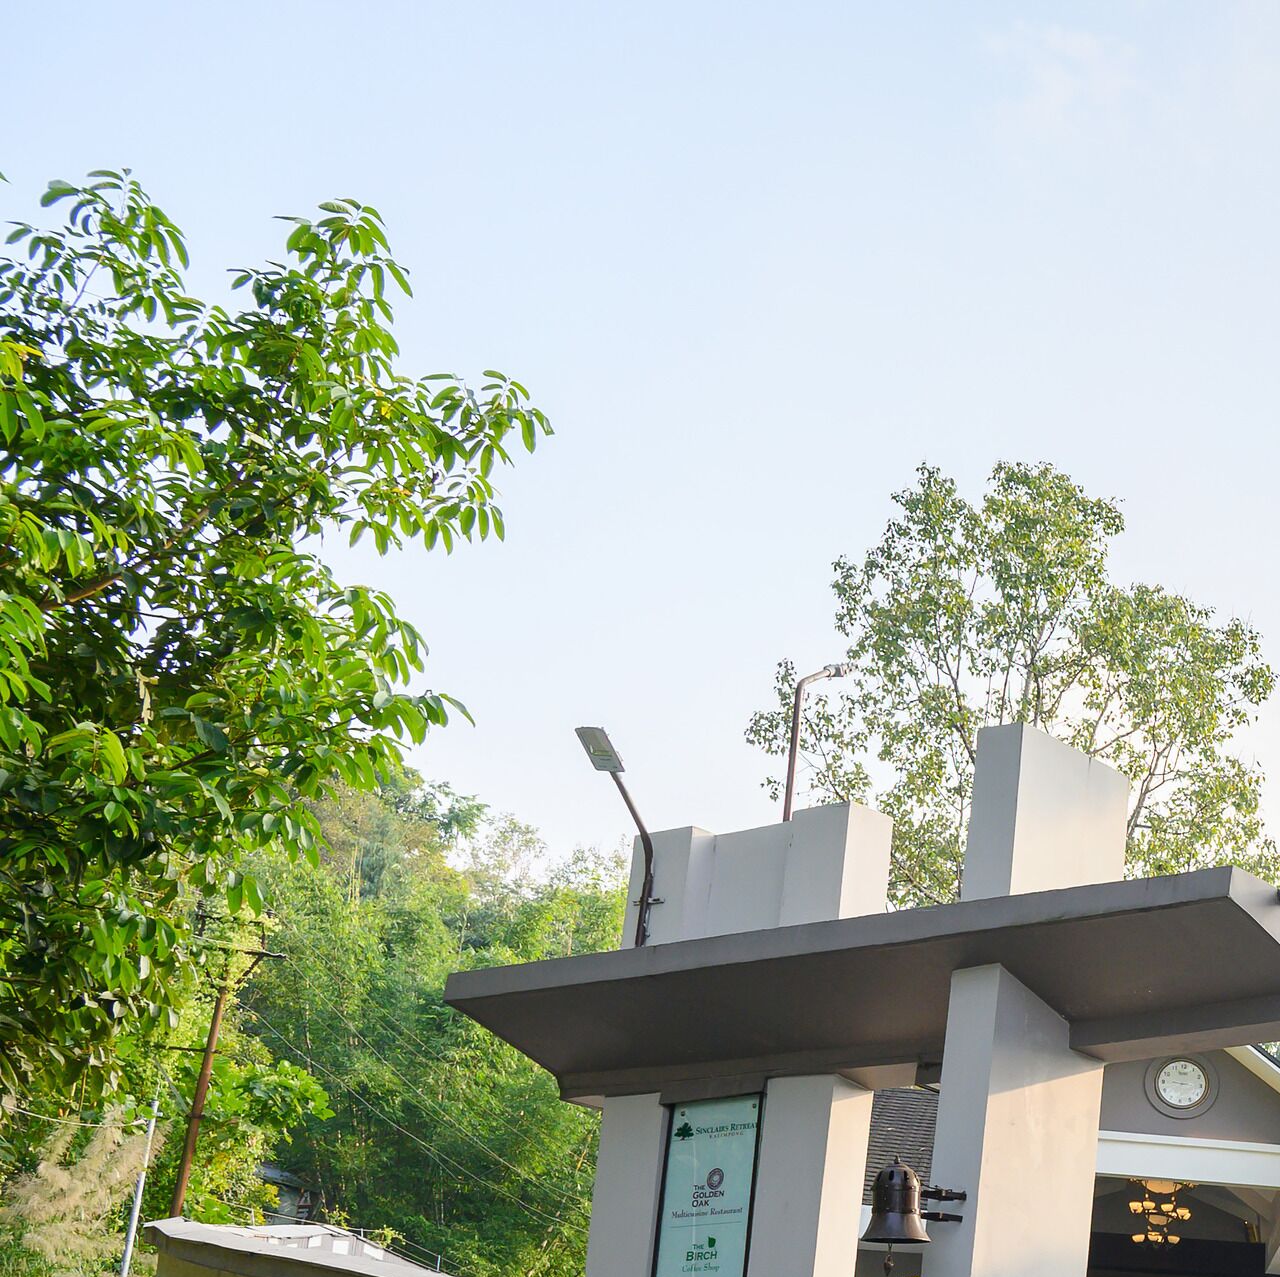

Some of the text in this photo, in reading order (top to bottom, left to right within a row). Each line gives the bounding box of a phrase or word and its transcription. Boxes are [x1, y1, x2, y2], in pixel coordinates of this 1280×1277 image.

[693, 1191, 724, 1199] GOLDEN
[686, 1250, 718, 1261] BIRCH
[703, 1262, 720, 1273] Shop
